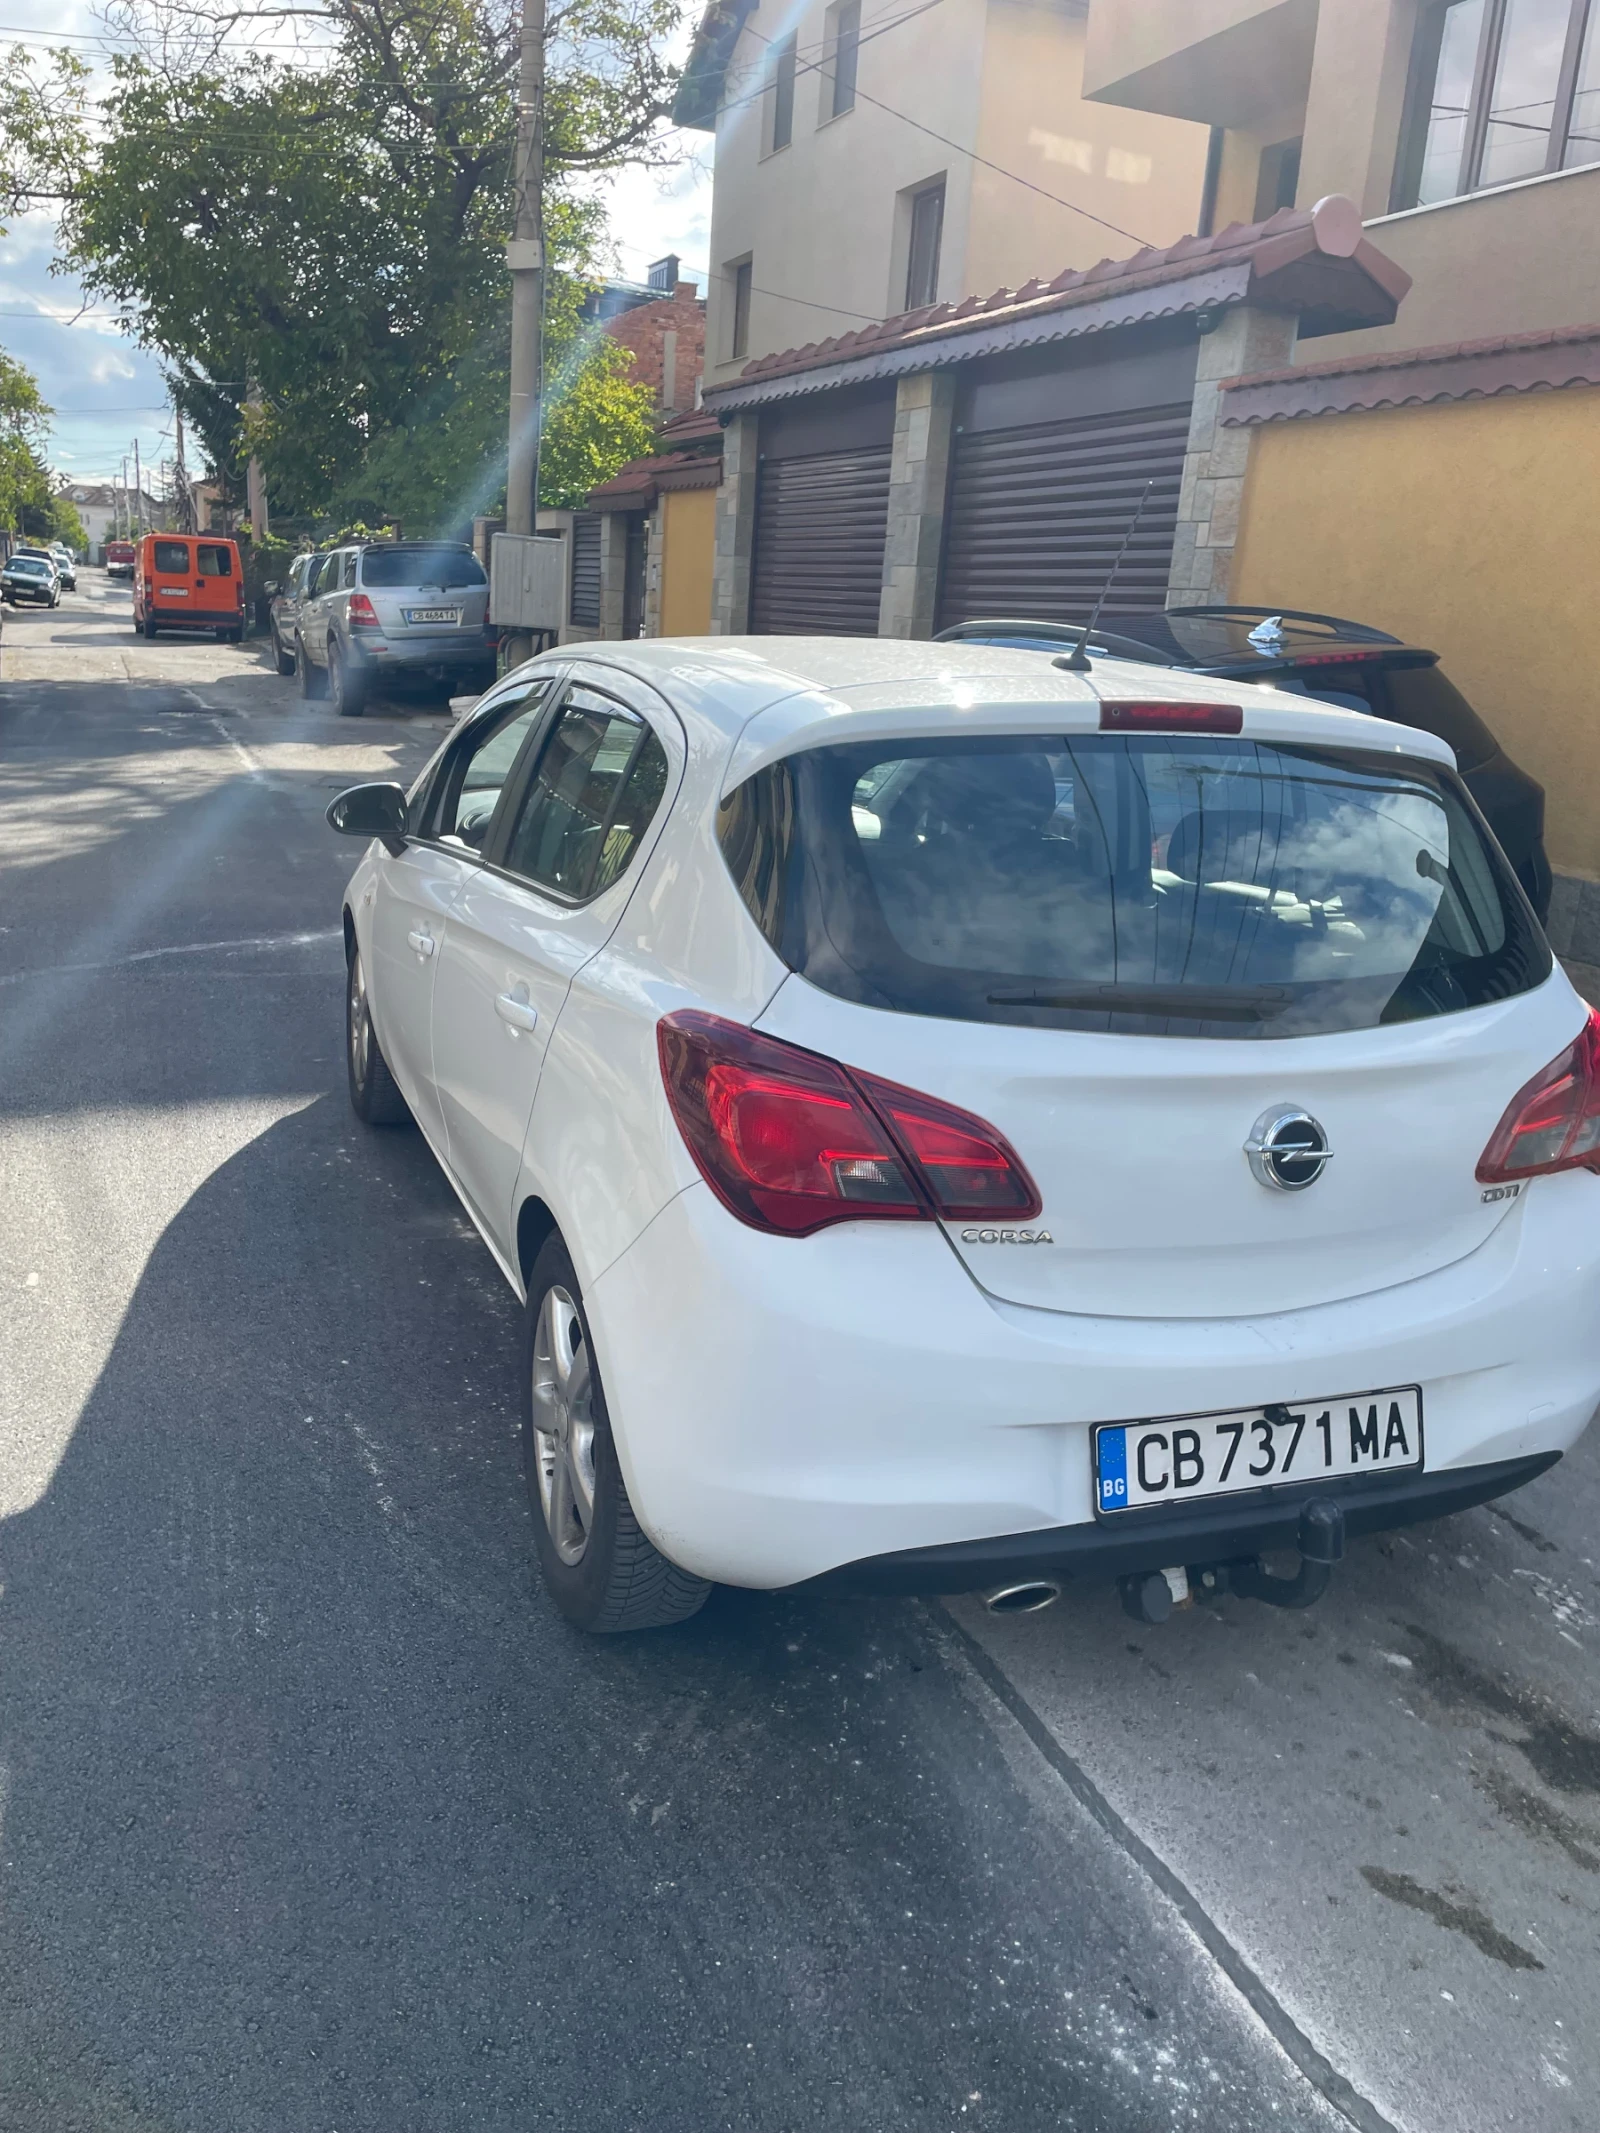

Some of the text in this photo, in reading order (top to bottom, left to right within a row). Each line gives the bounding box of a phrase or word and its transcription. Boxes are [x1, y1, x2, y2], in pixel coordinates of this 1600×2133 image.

[961, 1229, 1054, 1244] CORSA
[1137, 1402, 1409, 1492] CB 7371 MA
[1103, 1477, 1125, 1498] BG
